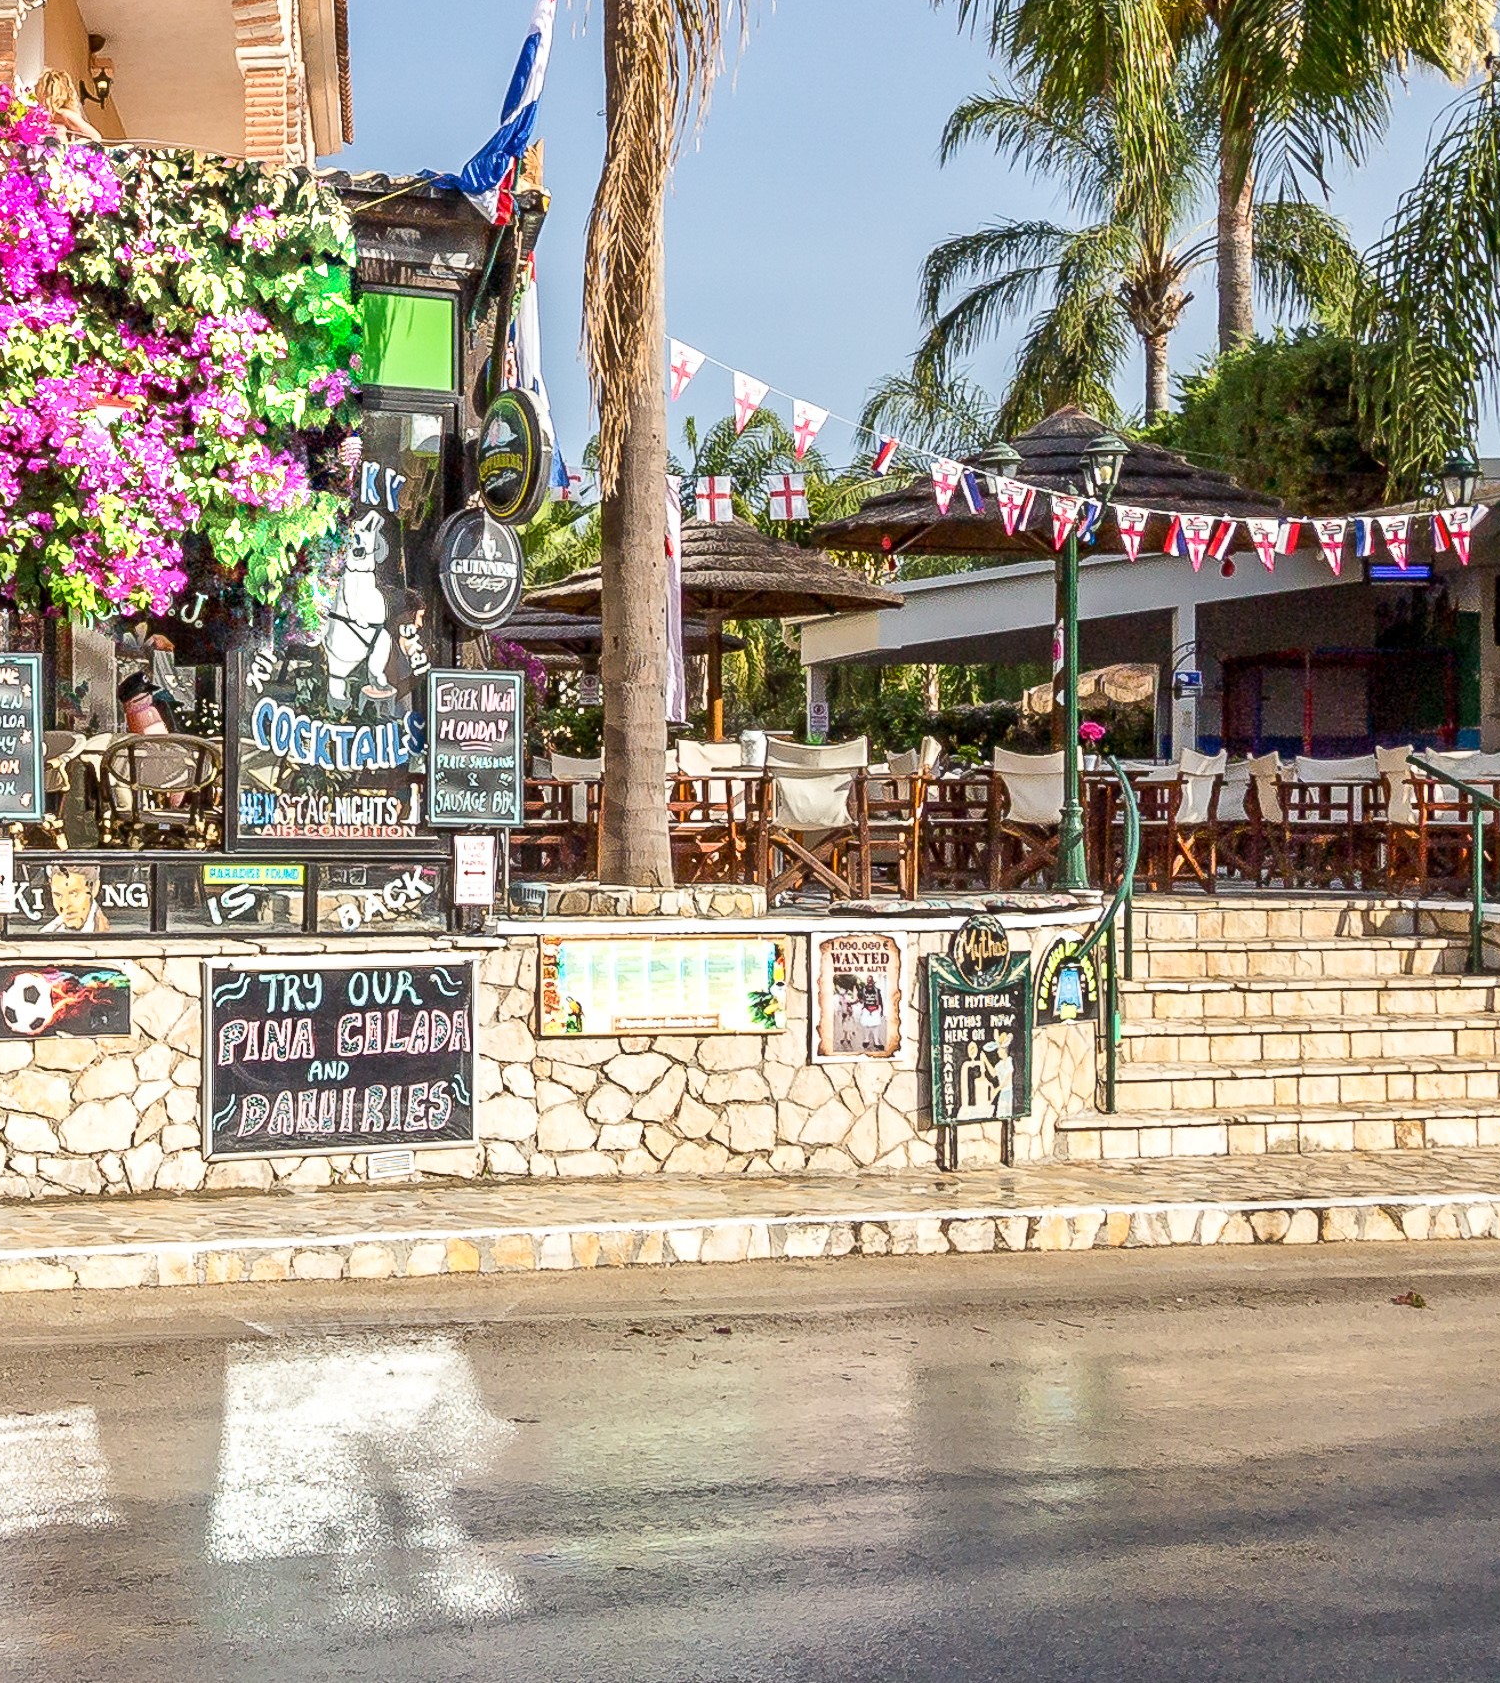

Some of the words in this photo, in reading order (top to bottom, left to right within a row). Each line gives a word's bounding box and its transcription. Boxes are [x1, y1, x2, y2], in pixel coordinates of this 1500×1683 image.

[449, 558, 518, 580] GUINNESS
[435, 682, 480, 713] GREEK
[251, 696, 426, 771] COCKTAILS
[439, 717, 509, 743] MONDAY
[435, 789, 488, 814] SAUSAGE
[259, 824, 417, 838] AIR-CONDITION
[206, 882, 256, 926] IS
[337, 864, 435, 932] BACK
[830, 952, 891, 965] WANTED
[957, 928, 1008, 971] Mythos
[833, 965, 853, 973] DEAD
[258, 972, 323, 1013] TRY
[349, 970, 424, 1006] OUR
[940, 994, 961, 1009] THE
[964, 993, 1012, 1008] MYTHICAL
[943, 1014, 983, 1029] MYTHOS
[217, 1018, 316, 1066] PINA
[307, 1060, 350, 1084] AND
[236, 1080, 453, 1137] DAQUIRIES
